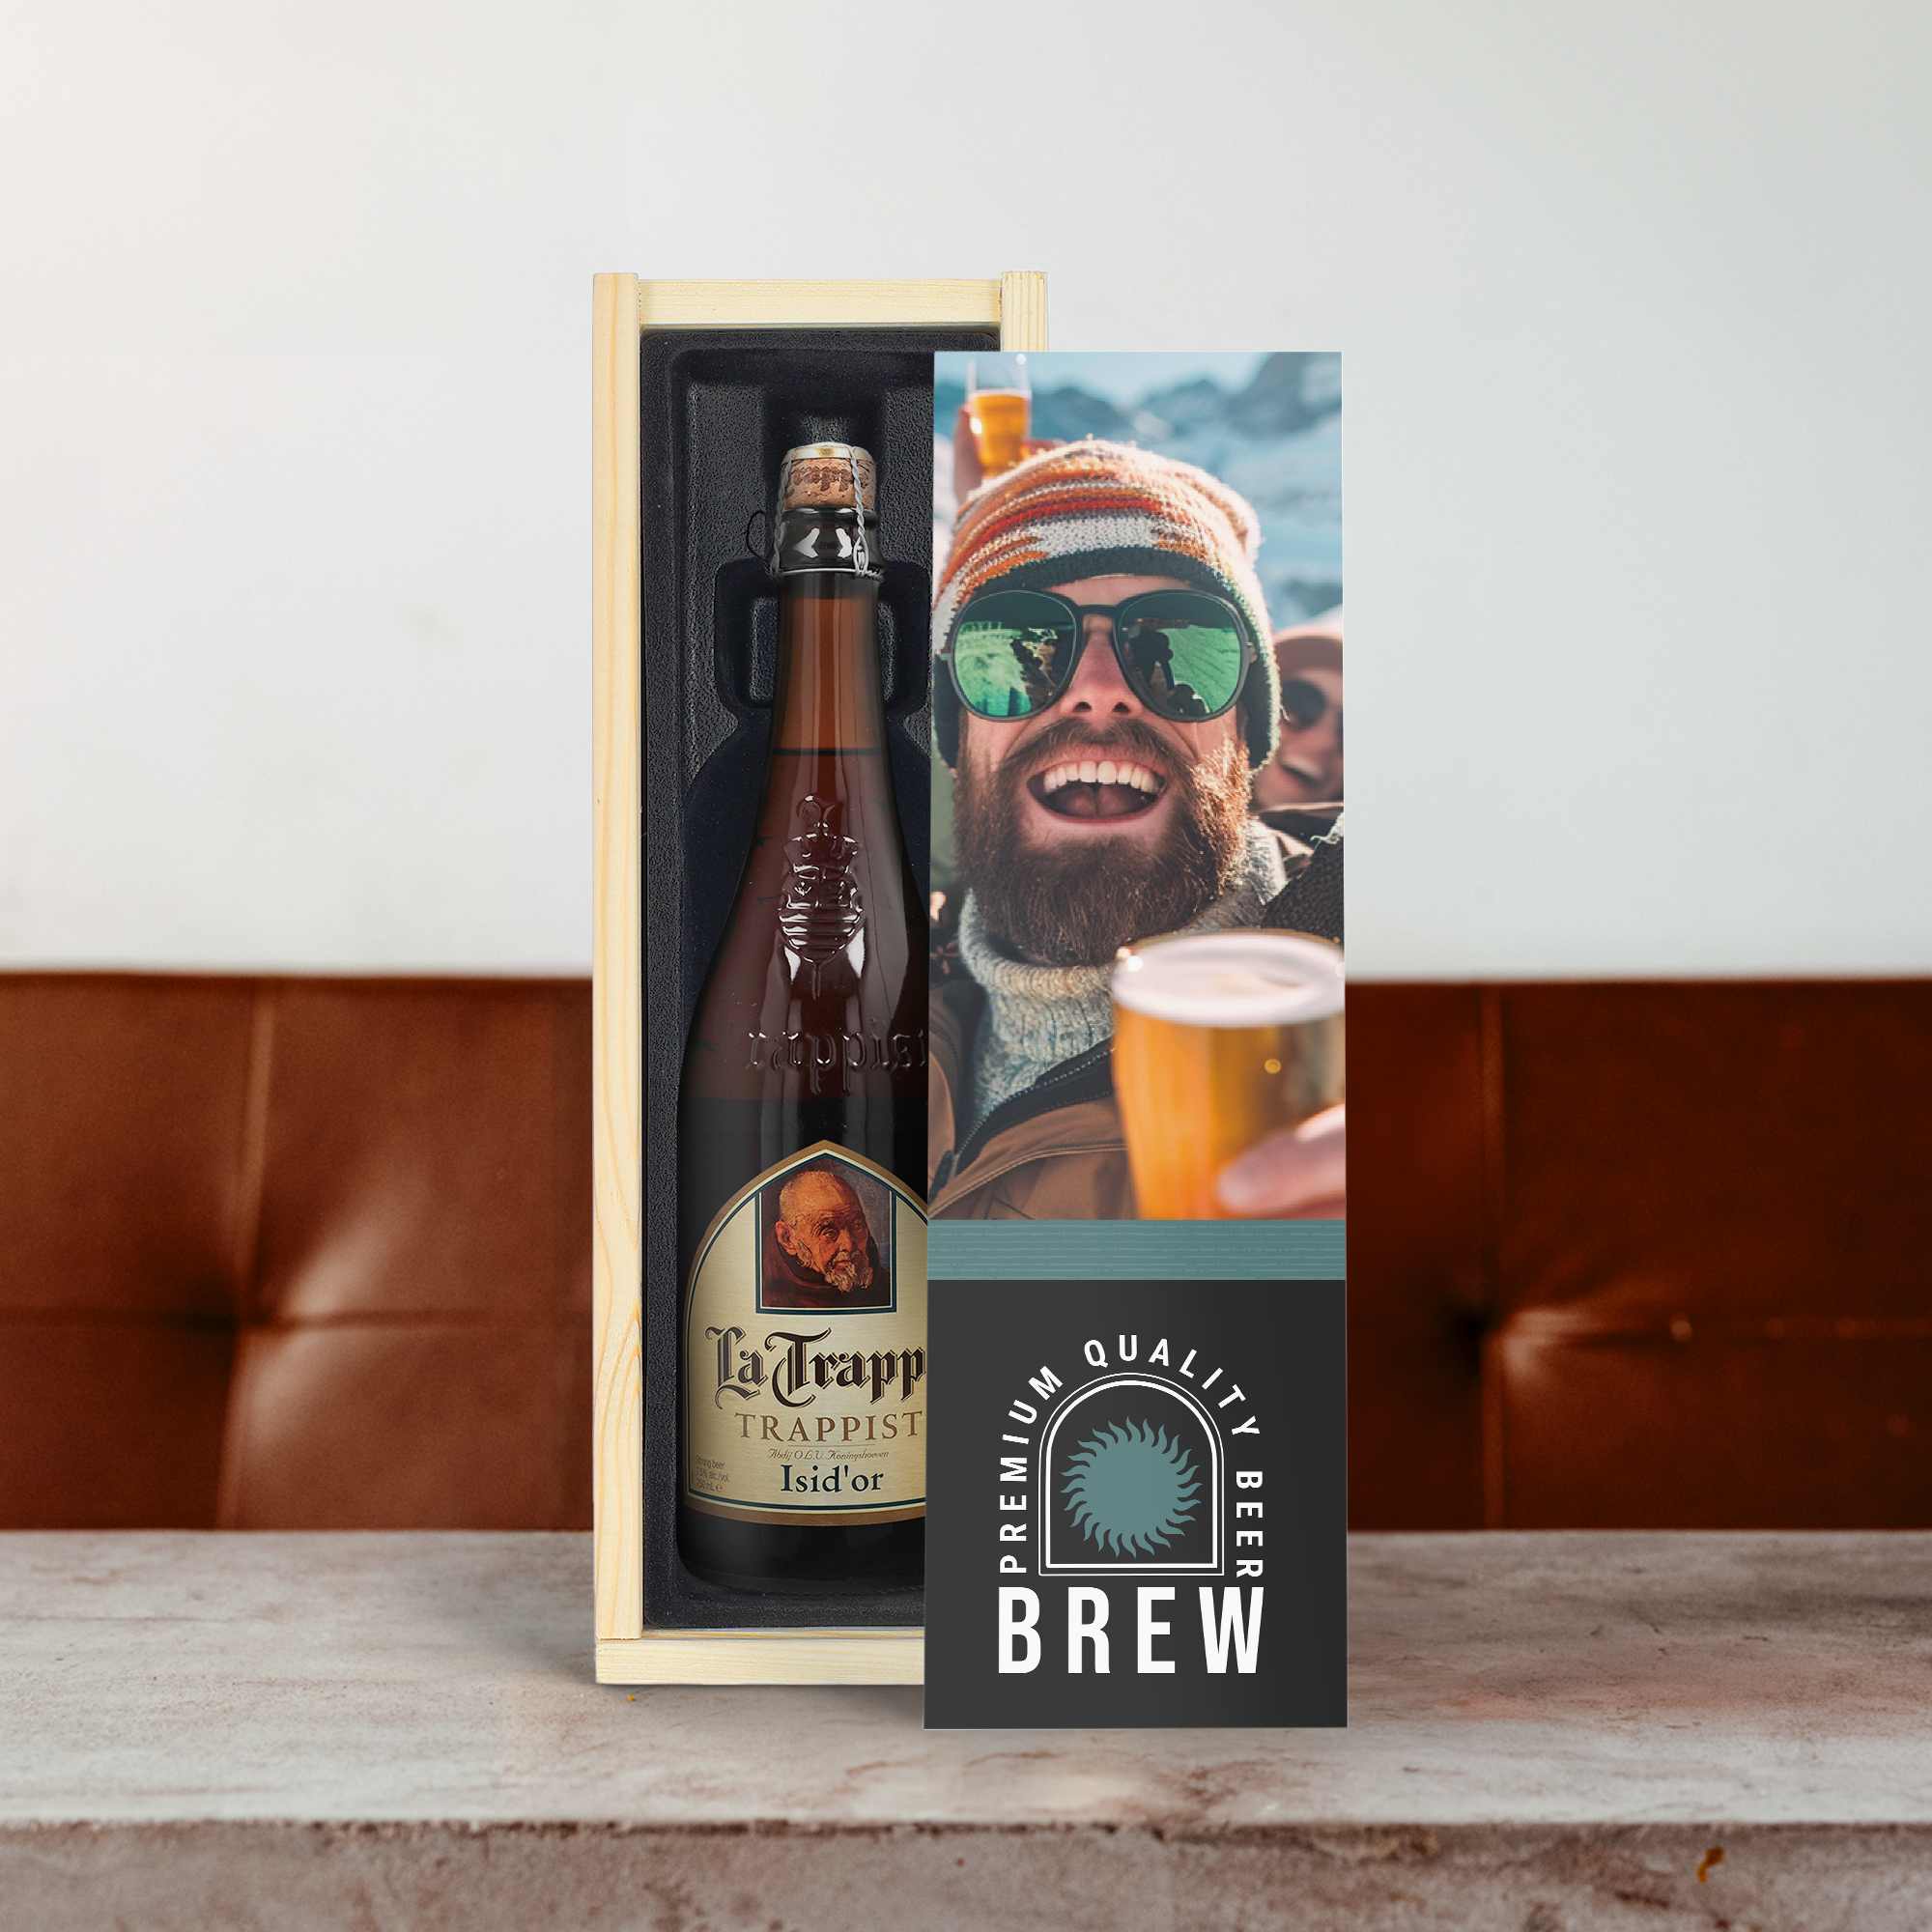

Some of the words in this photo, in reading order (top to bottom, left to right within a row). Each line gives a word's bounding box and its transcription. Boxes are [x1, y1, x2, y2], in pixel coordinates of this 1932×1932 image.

[705, 1326, 769, 1409] La
[734, 1410, 923, 1442] TRAPPIST
[696, 1455, 711, 1469] Strong
[712, 1459, 725, 1470] beer
[768, 1449, 792, 1463] Abdij
[825, 1449, 890, 1463] Koningshoeven
[999, 1365, 1063, 1573] PREMIUM
[1084, 1334, 1260, 1435] QUALITY
[1236, 1471, 1264, 1577] BEER
[696, 1478, 706, 1490] 750
[781, 1464, 884, 1493] Isid'or
[998, 1586, 1264, 1674] BREW
